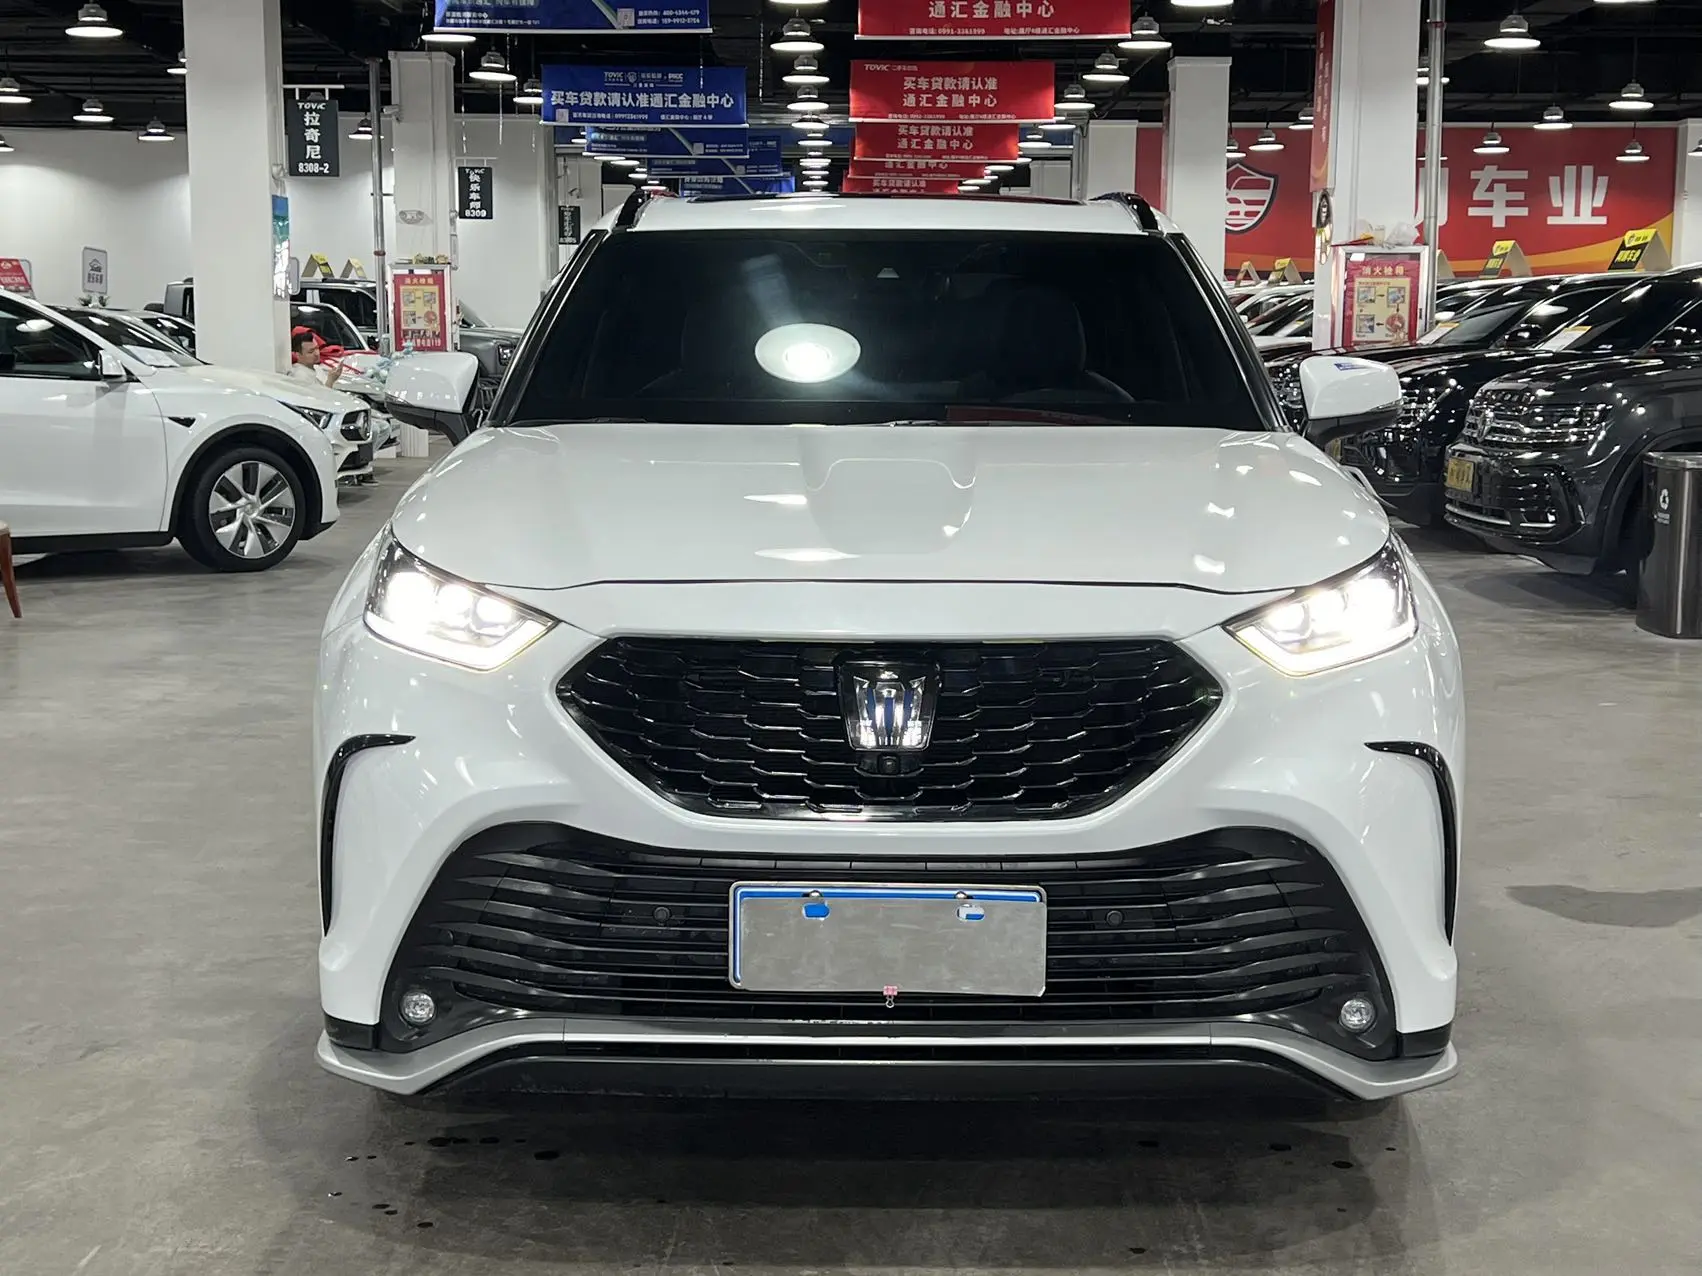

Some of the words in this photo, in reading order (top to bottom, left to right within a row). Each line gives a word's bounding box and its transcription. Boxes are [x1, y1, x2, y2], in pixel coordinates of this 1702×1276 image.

[929, 0, 1054, 18] 通汇金融中心
[903, 77, 998, 91] 买车贷款请认准
[297, 102, 326, 110] TOVIC
[551, 90, 734, 109] 买车贷款请认准通汇金融中心
[902, 94, 998, 108] 通汇金融中心
[303, 111, 322, 159] 拉奇尼
[898, 125, 974, 137] 买车贷款请认准
[897, 139, 974, 150] 通汇金融中心
[298, 162, 330, 174] 8308-2
[464, 209, 487, 218] 8309
